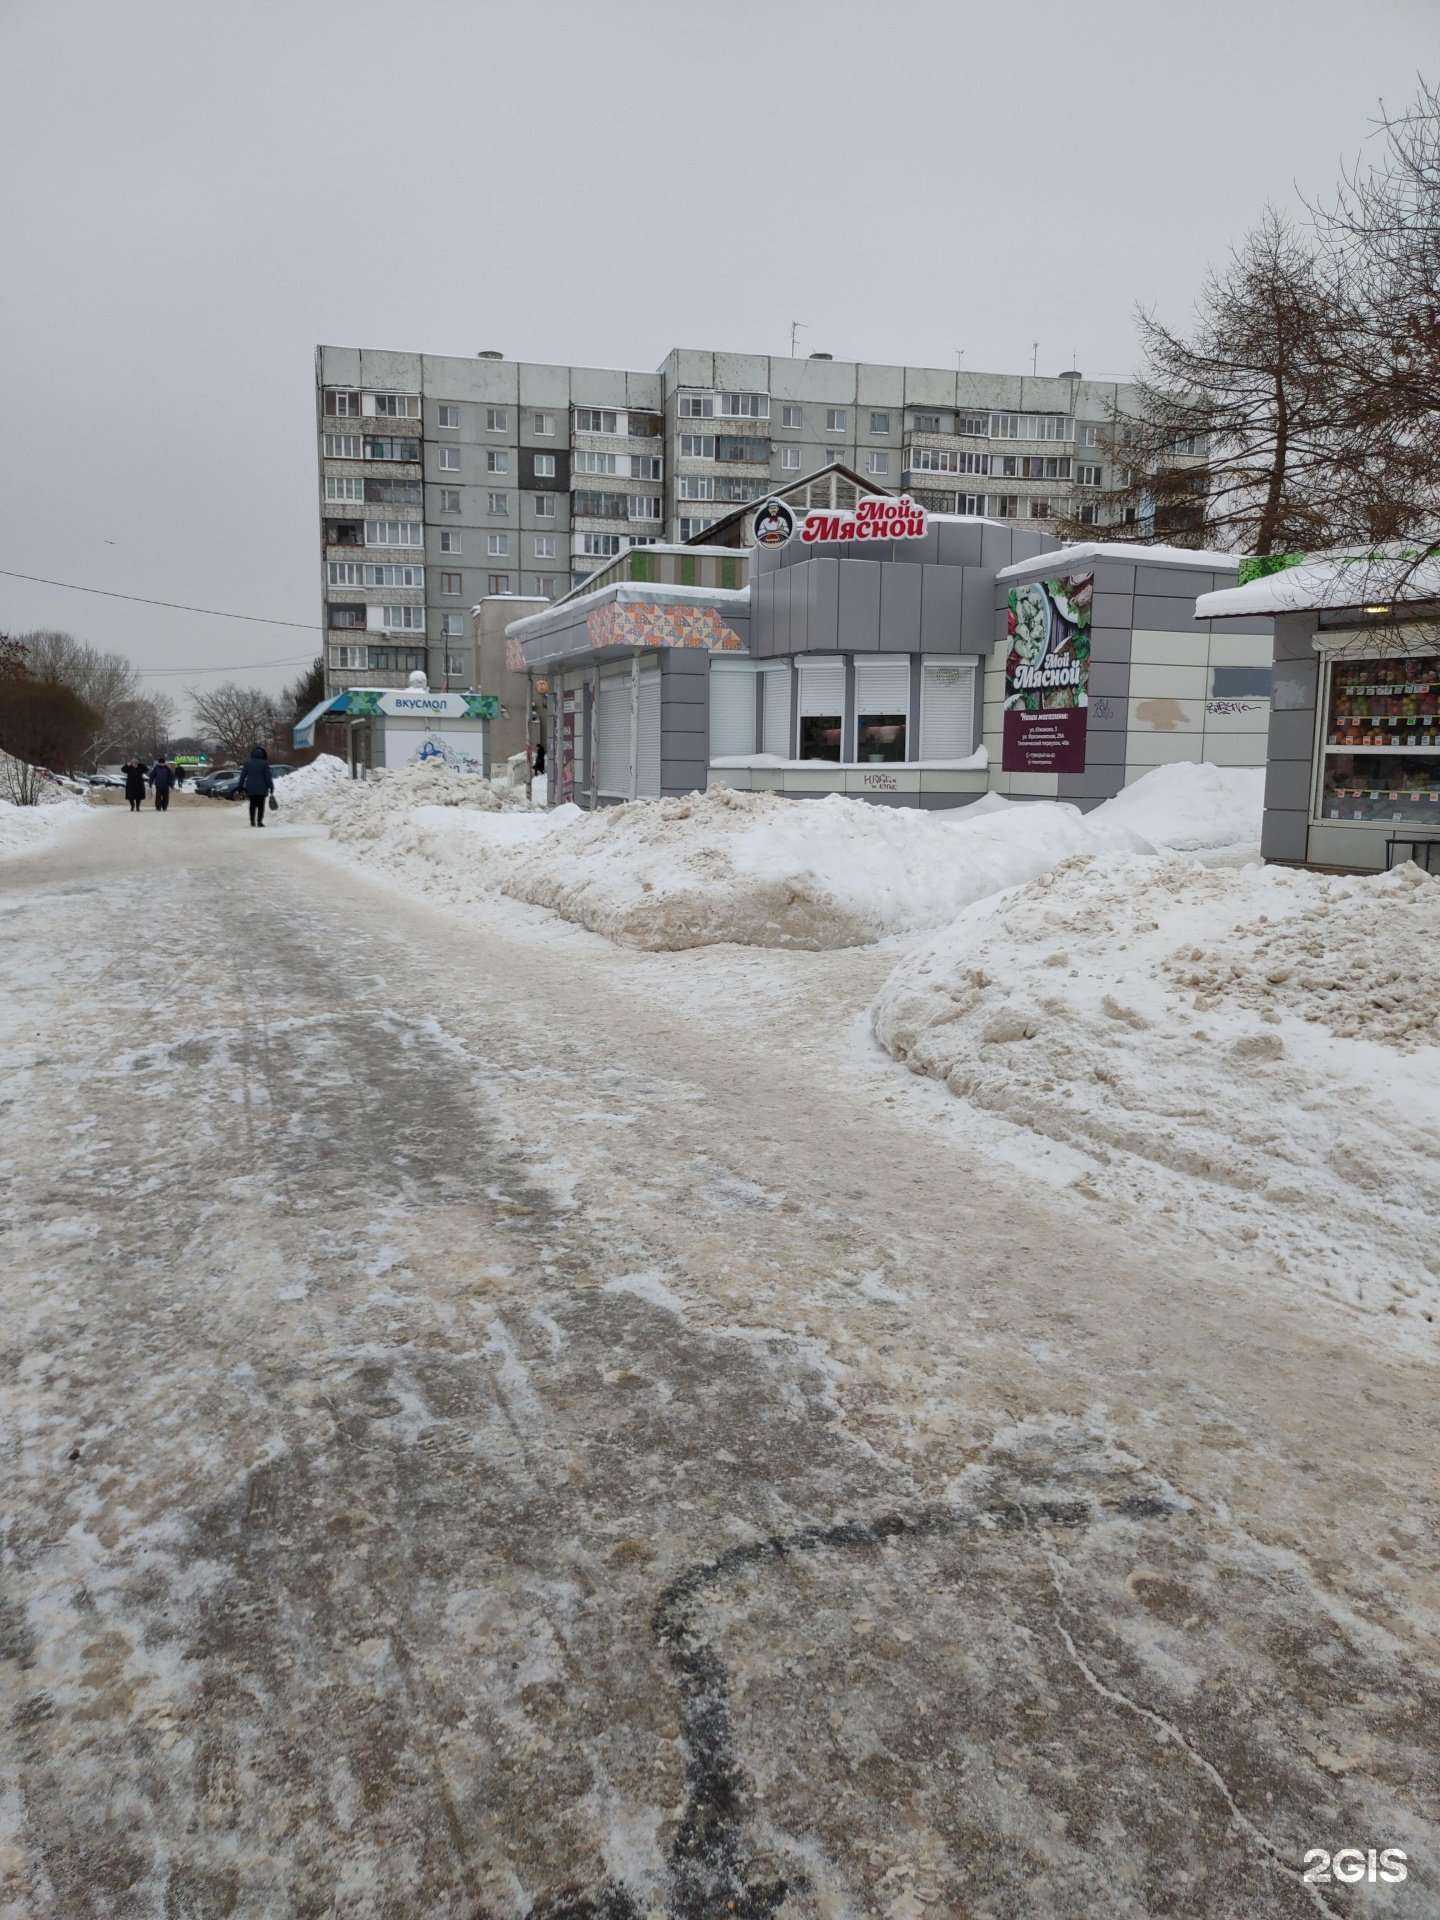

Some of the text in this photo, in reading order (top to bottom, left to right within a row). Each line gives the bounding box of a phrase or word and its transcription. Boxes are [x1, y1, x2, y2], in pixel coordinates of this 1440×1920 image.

[856, 500, 910, 521] Мой
[801, 510, 924, 542] Мясной
[1044, 652, 1070, 669] Мой
[1013, 660, 1081, 690] Мясной
[395, 698, 447, 710] ВКУСМОЛ
